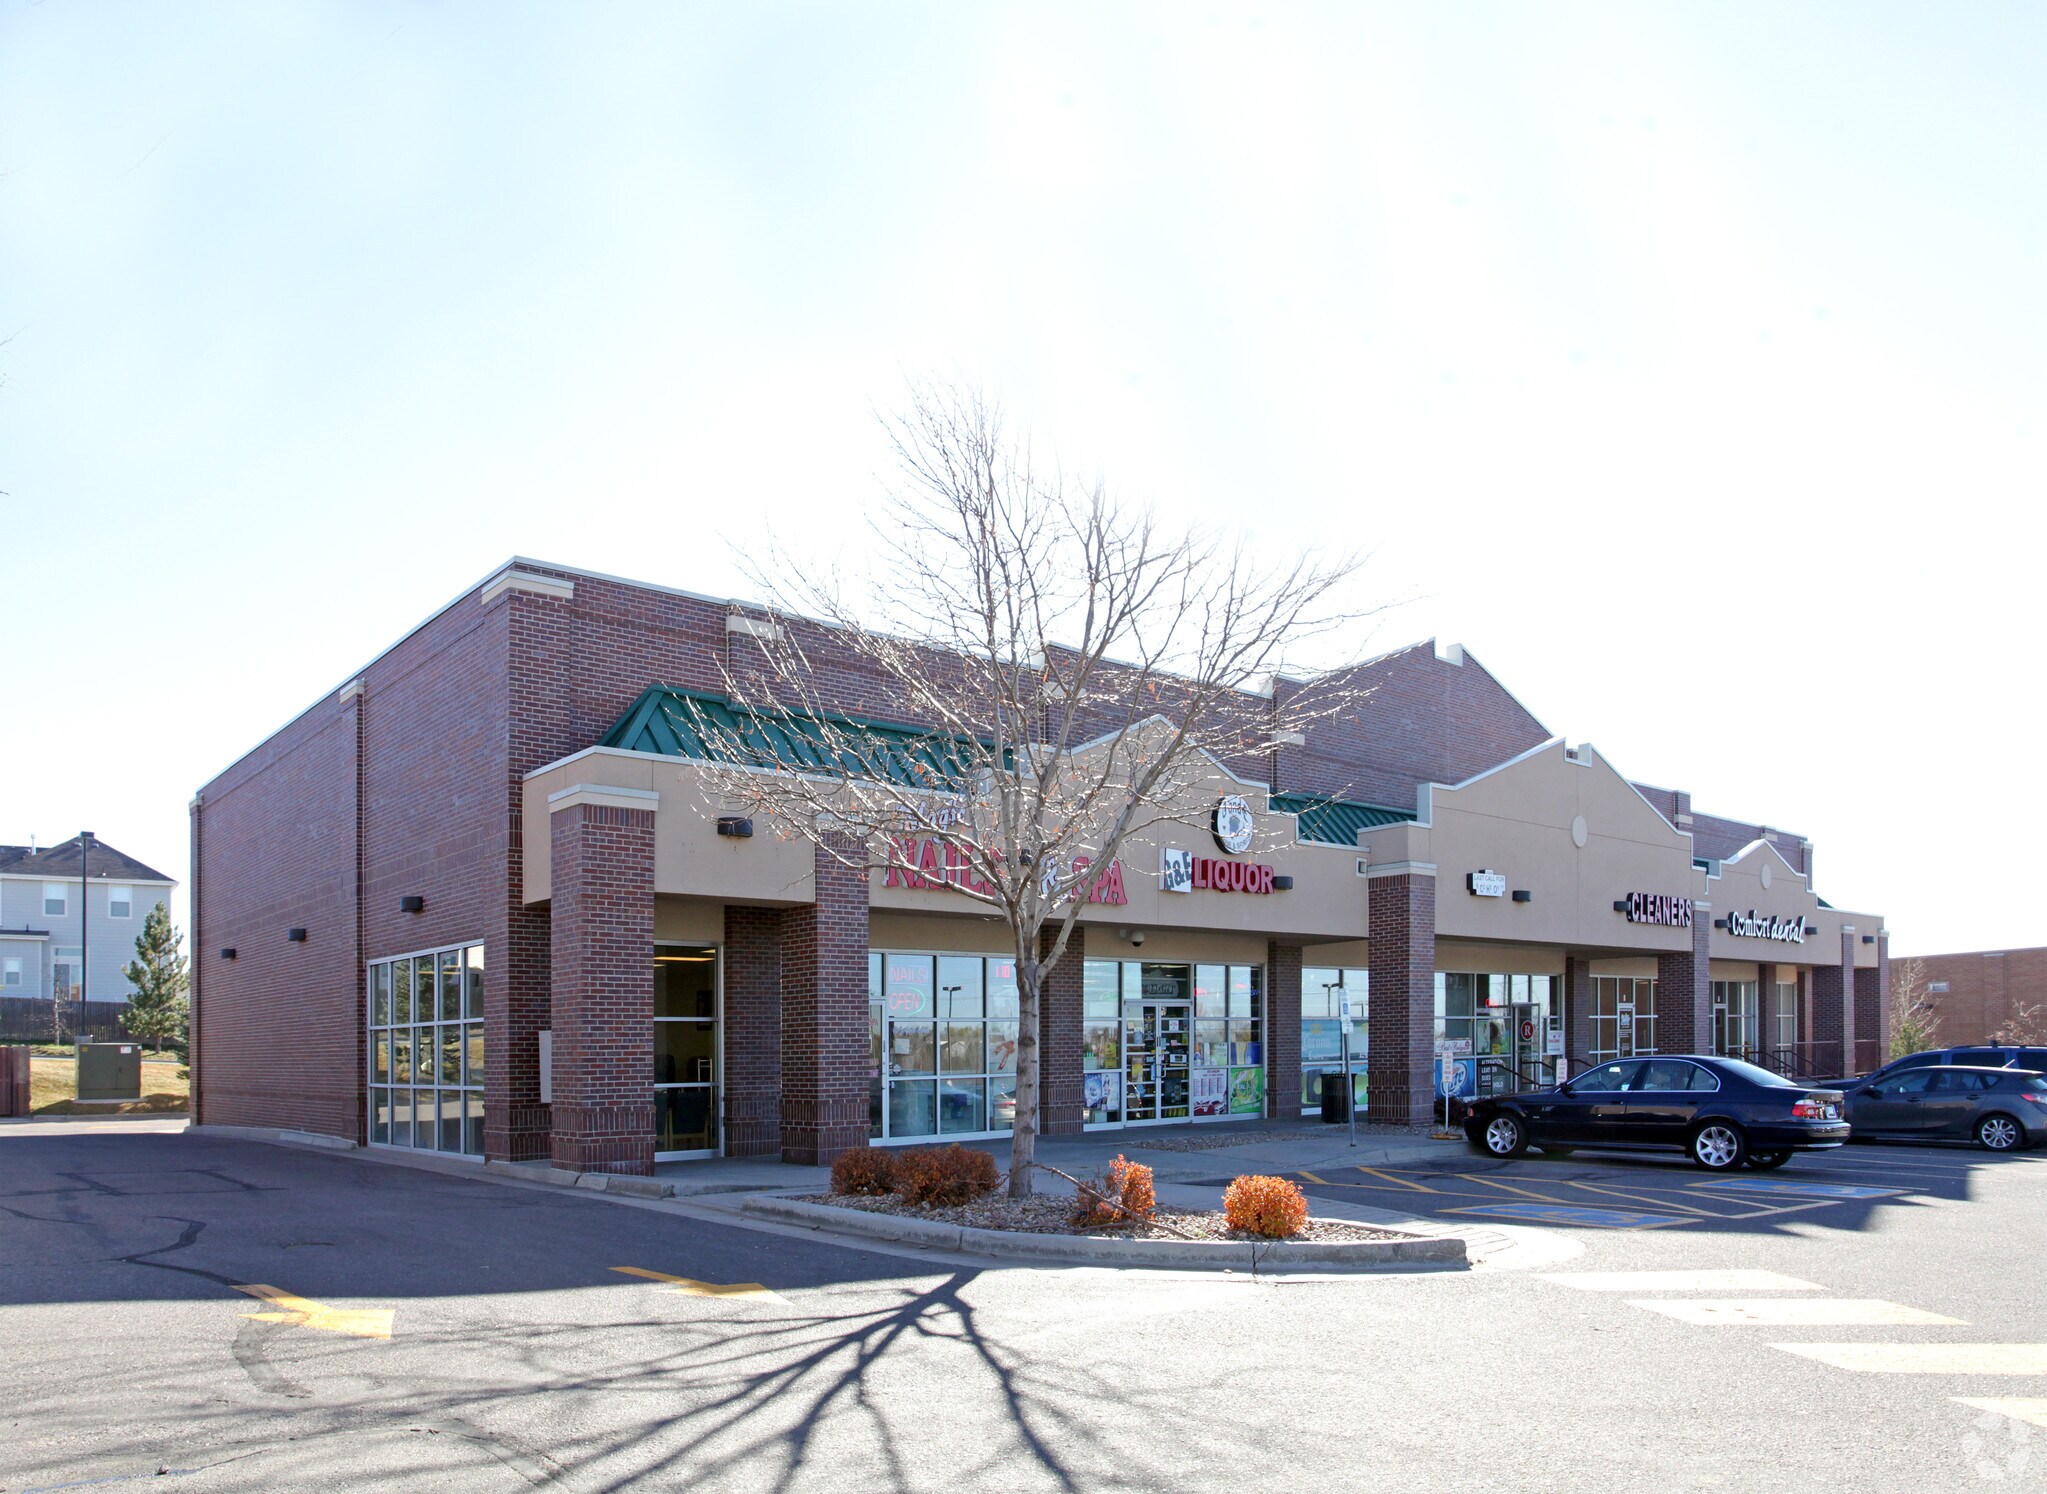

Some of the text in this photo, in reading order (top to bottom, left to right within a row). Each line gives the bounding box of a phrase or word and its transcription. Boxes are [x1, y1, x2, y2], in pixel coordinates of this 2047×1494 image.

[1070, 855, 1128, 905] SPA
[1193, 857, 1275, 894] LIQUOR
[1631, 892, 1692, 928] CLEANERS
[1732, 910, 1806, 943] Comfort dental
[890, 967, 926, 982] NAILS
[889, 993, 920, 1010] OPEN
[1525, 1025, 1531, 1036] R
